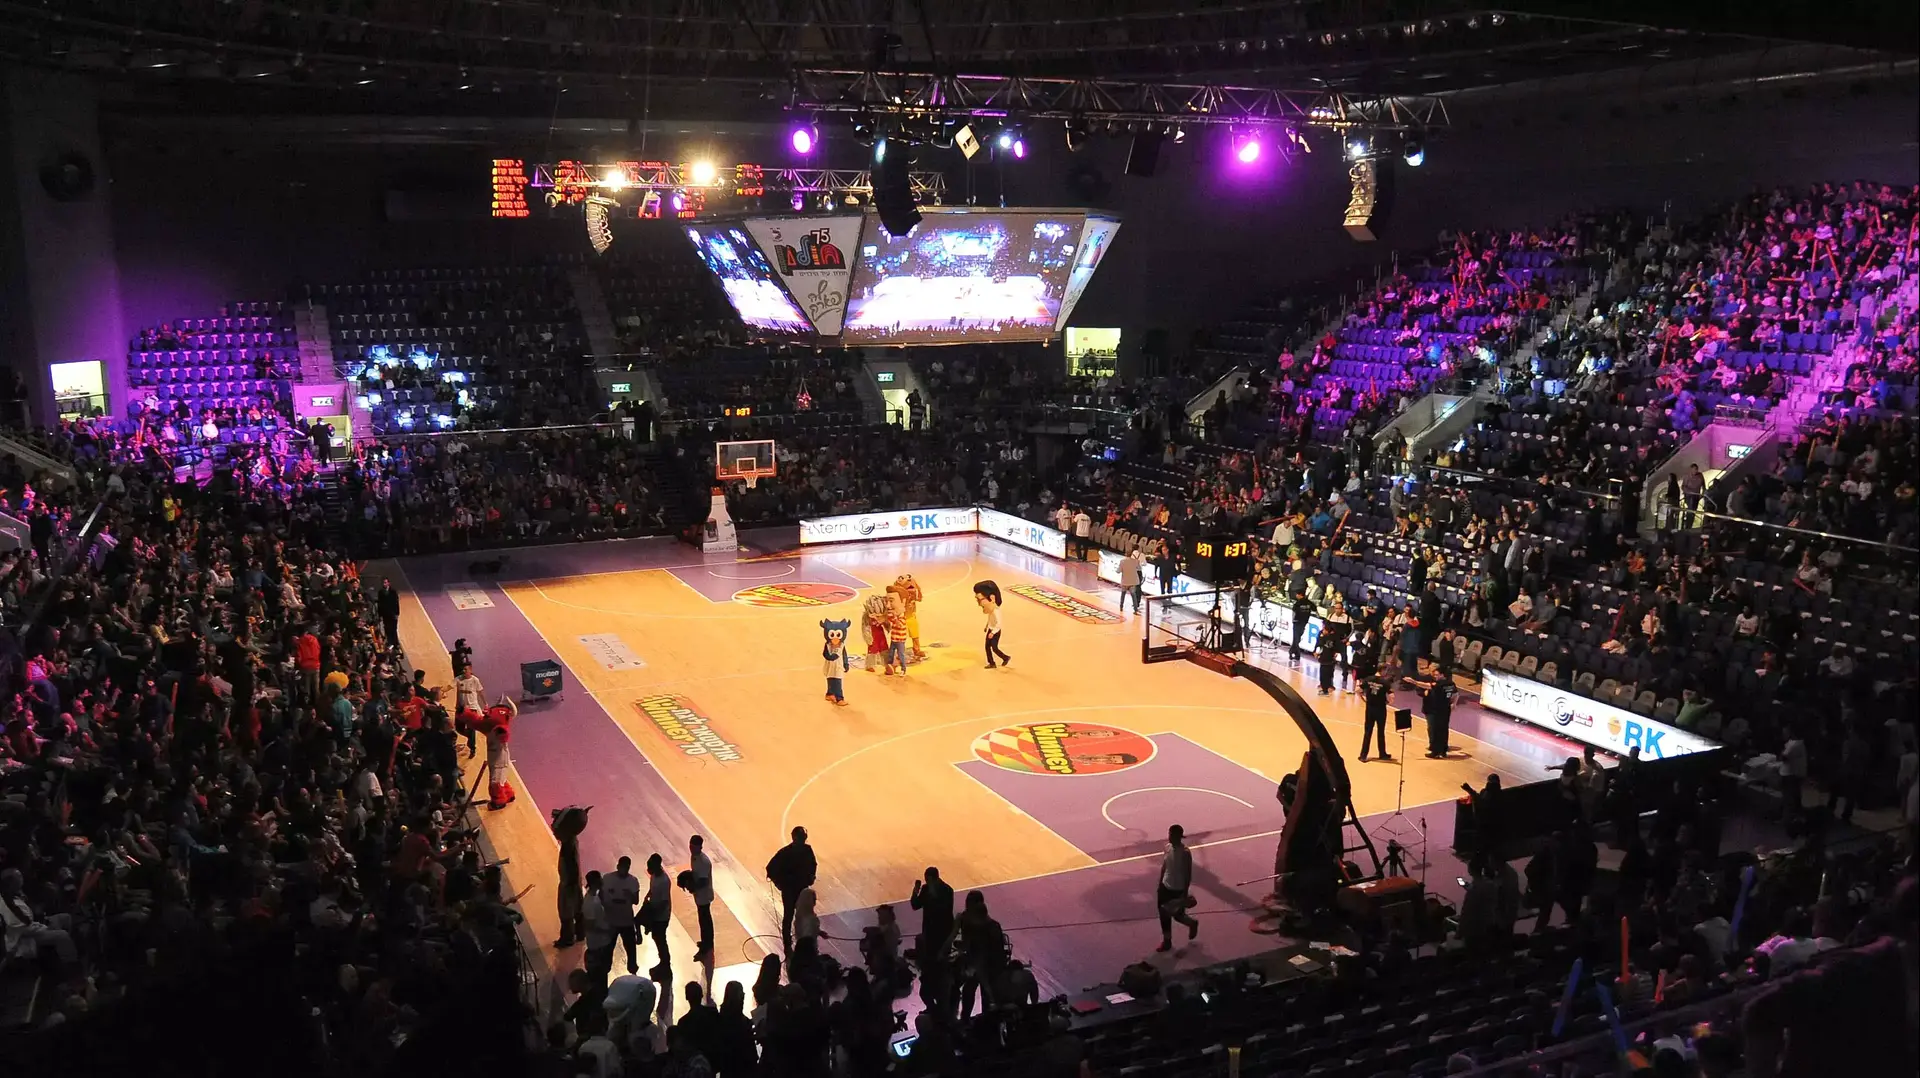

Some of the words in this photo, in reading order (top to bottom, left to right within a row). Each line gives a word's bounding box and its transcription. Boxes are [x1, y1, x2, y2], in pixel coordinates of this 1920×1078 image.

[811, 229, 830, 245] 75
[911, 513, 939, 531] RK
[1030, 527, 1045, 546] RK
[1224, 542, 1247, 557] 1:37
[639, 697, 697, 743] Winner
[680, 741, 708, 756] סל
[690, 724, 741, 761] אולסטאר
[1030, 722, 1076, 775] Winner
[1624, 720, 1666, 758] RK
